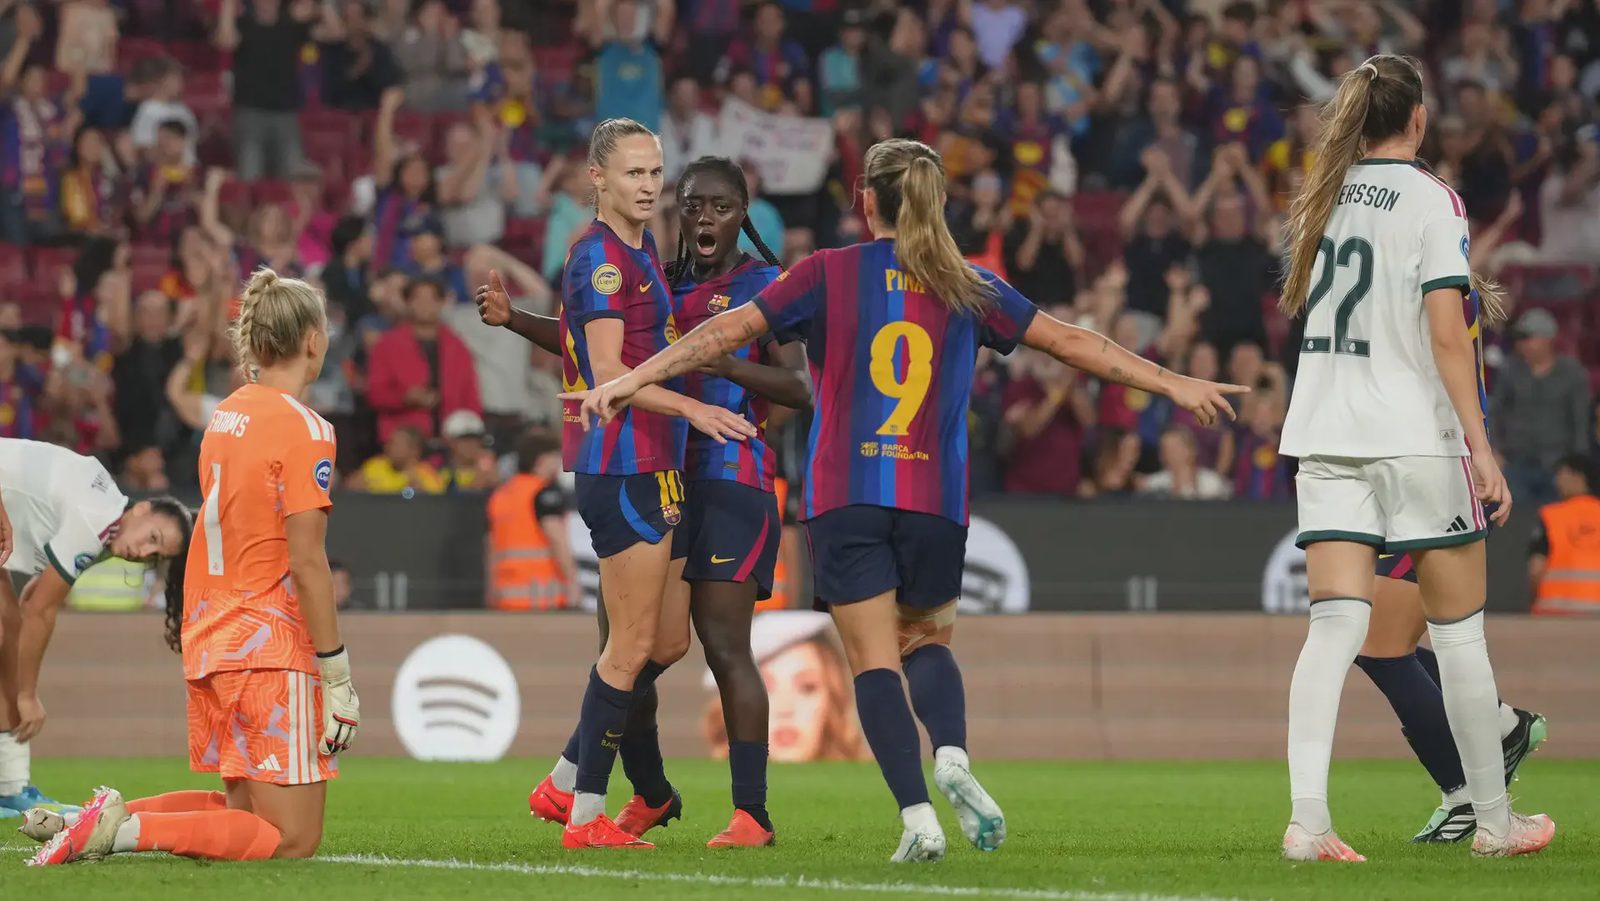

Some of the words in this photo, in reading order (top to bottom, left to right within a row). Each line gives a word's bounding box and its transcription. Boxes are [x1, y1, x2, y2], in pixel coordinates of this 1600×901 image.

[1337, 183, 1401, 212] ERSSON
[1301, 235, 1374, 357] 22
[869, 320, 934, 436] 9
[203, 463, 225, 576] 1
